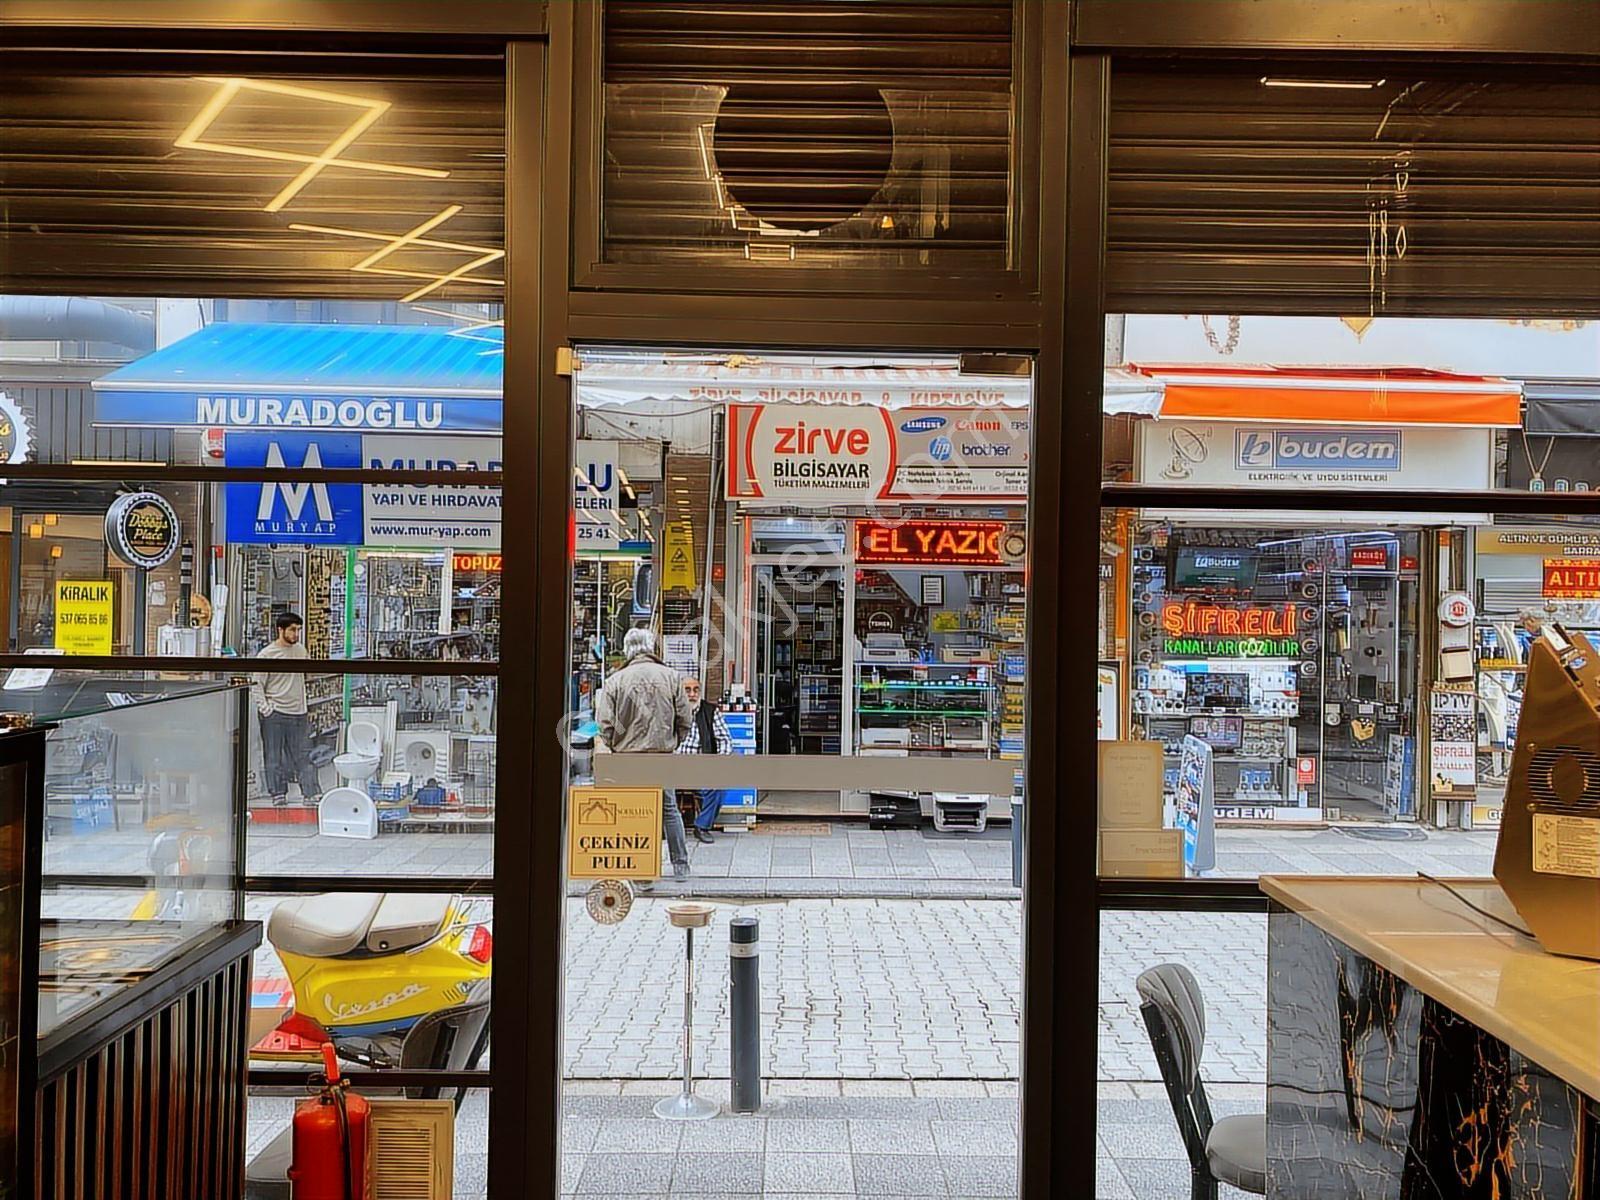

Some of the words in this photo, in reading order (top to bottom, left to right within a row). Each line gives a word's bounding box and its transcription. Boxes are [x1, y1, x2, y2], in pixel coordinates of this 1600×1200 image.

[197, 397, 443, 429] MURADOĞLU
[774, 421, 870, 455] zirve
[961, 443, 1011, 457] brother
[1279, 435, 1396, 460] budem
[773, 458, 870, 478] BİLGİSAYAR
[372, 493, 404, 506] YAPI
[408, 494, 427, 506] VE
[574, 498, 613, 510] ELERI
[370, 525, 492, 538] www.mur-yap.com
[578, 528, 593, 539] 25
[1499, 534, 1530, 543] ALTIN
[870, 528, 909, 553] EL
[1548, 570, 1600, 587] ALTI
[1162, 603, 1297, 638] ŞİFRELİ
[1214, 806, 1274, 820] udEM
[579, 832, 650, 853] ÇEKİNİZ
[592, 856, 637, 869] PULL
